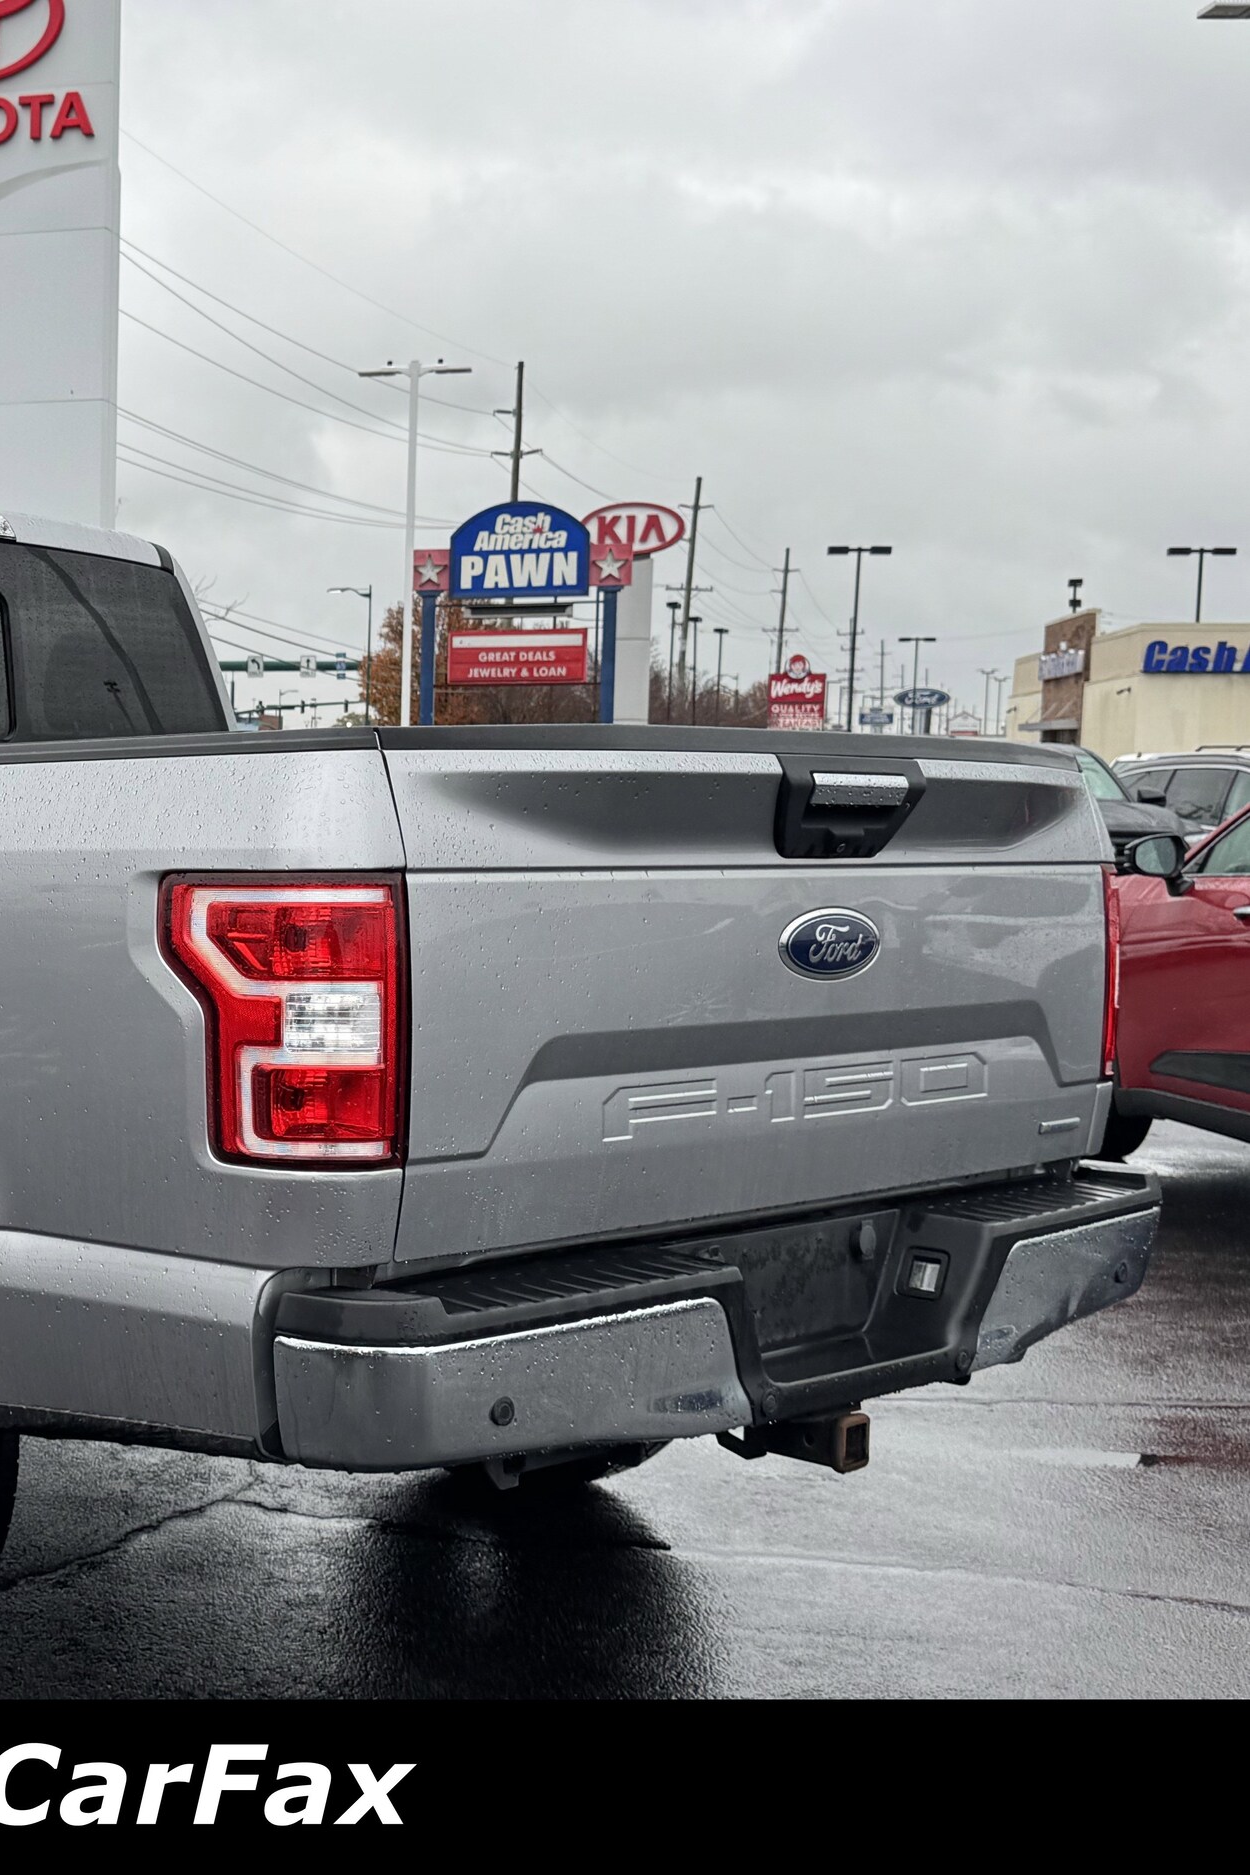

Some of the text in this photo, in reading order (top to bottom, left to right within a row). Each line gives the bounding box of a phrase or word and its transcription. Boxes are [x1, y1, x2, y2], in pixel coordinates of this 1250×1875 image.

[494, 512, 552, 534] Cash
[597, 514, 667, 545] KIA
[473, 530, 568, 552] America
[460, 551, 578, 590] PAWN
[478, 651, 556, 663] GREAT DEALS
[1143, 640, 1238, 673] Cash
[468, 666, 567, 678] JEWELRY & LOAN
[771, 676, 823, 699] Wendy's
[771, 703, 820, 714] QUALITY
[809, 924, 864, 963] Ford
[602, 1051, 988, 1142] F-150
